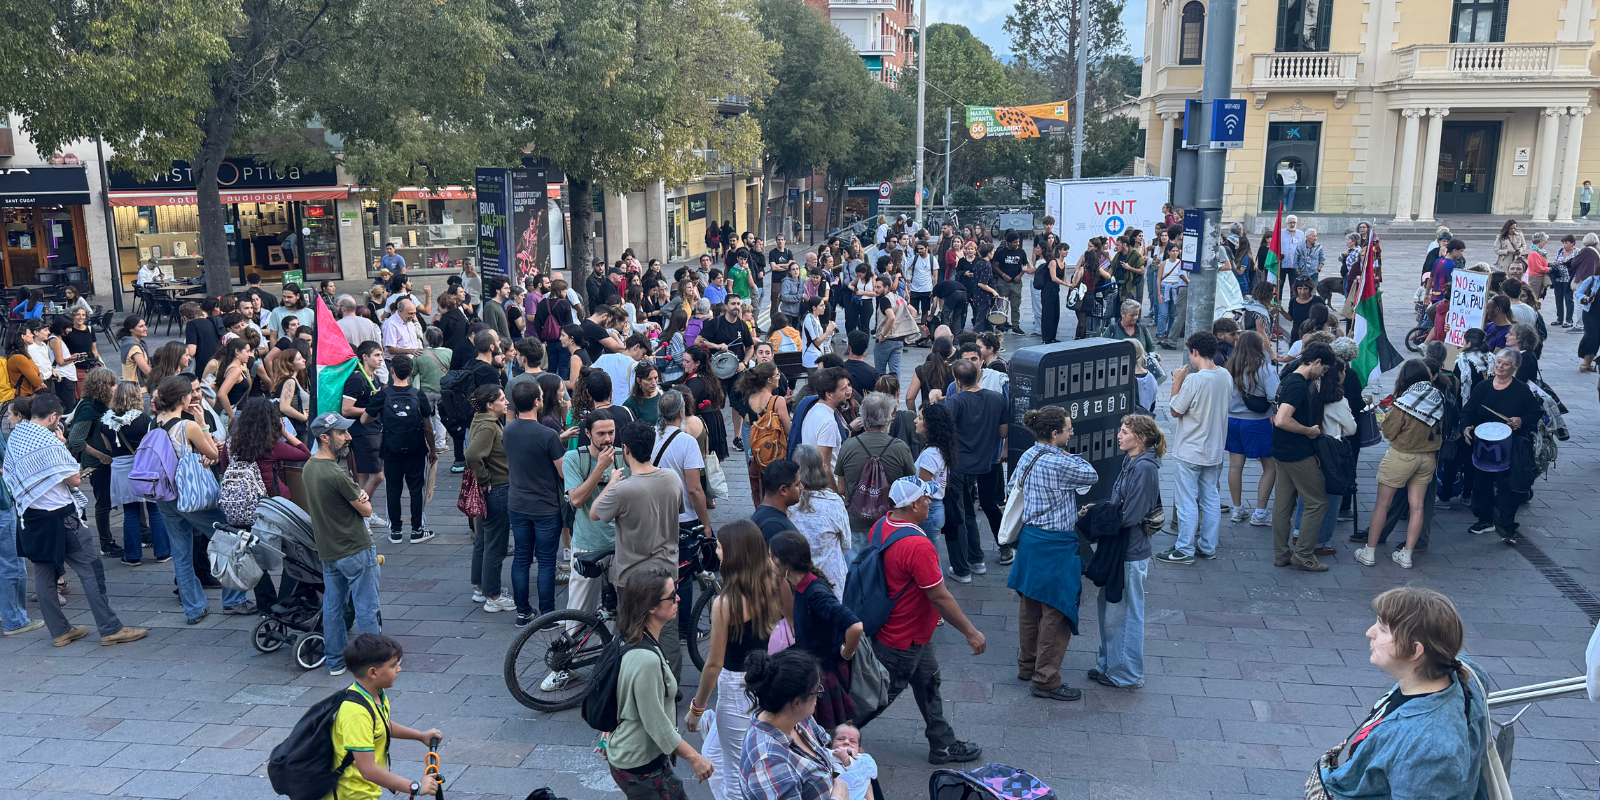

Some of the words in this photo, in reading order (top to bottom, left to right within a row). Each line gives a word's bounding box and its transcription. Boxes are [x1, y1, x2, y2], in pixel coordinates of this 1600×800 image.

[972, 124, 984, 133] 66
[153, 168, 193, 182] VIST
[227, 193, 293, 202] audiologia
[480, 213, 506, 227] TALENT
[481, 225, 495, 237] DAY
[1455, 275, 1468, 290] NO
[1468, 280, 1476, 292] ÉS
[1477, 285, 1484, 293] UN
[1453, 290, 1466, 306] PLA
[1470, 294, 1484, 310] PAU
[1452, 312, 1466, 328] PLA
[1449, 329, 1465, 346] NEGO
